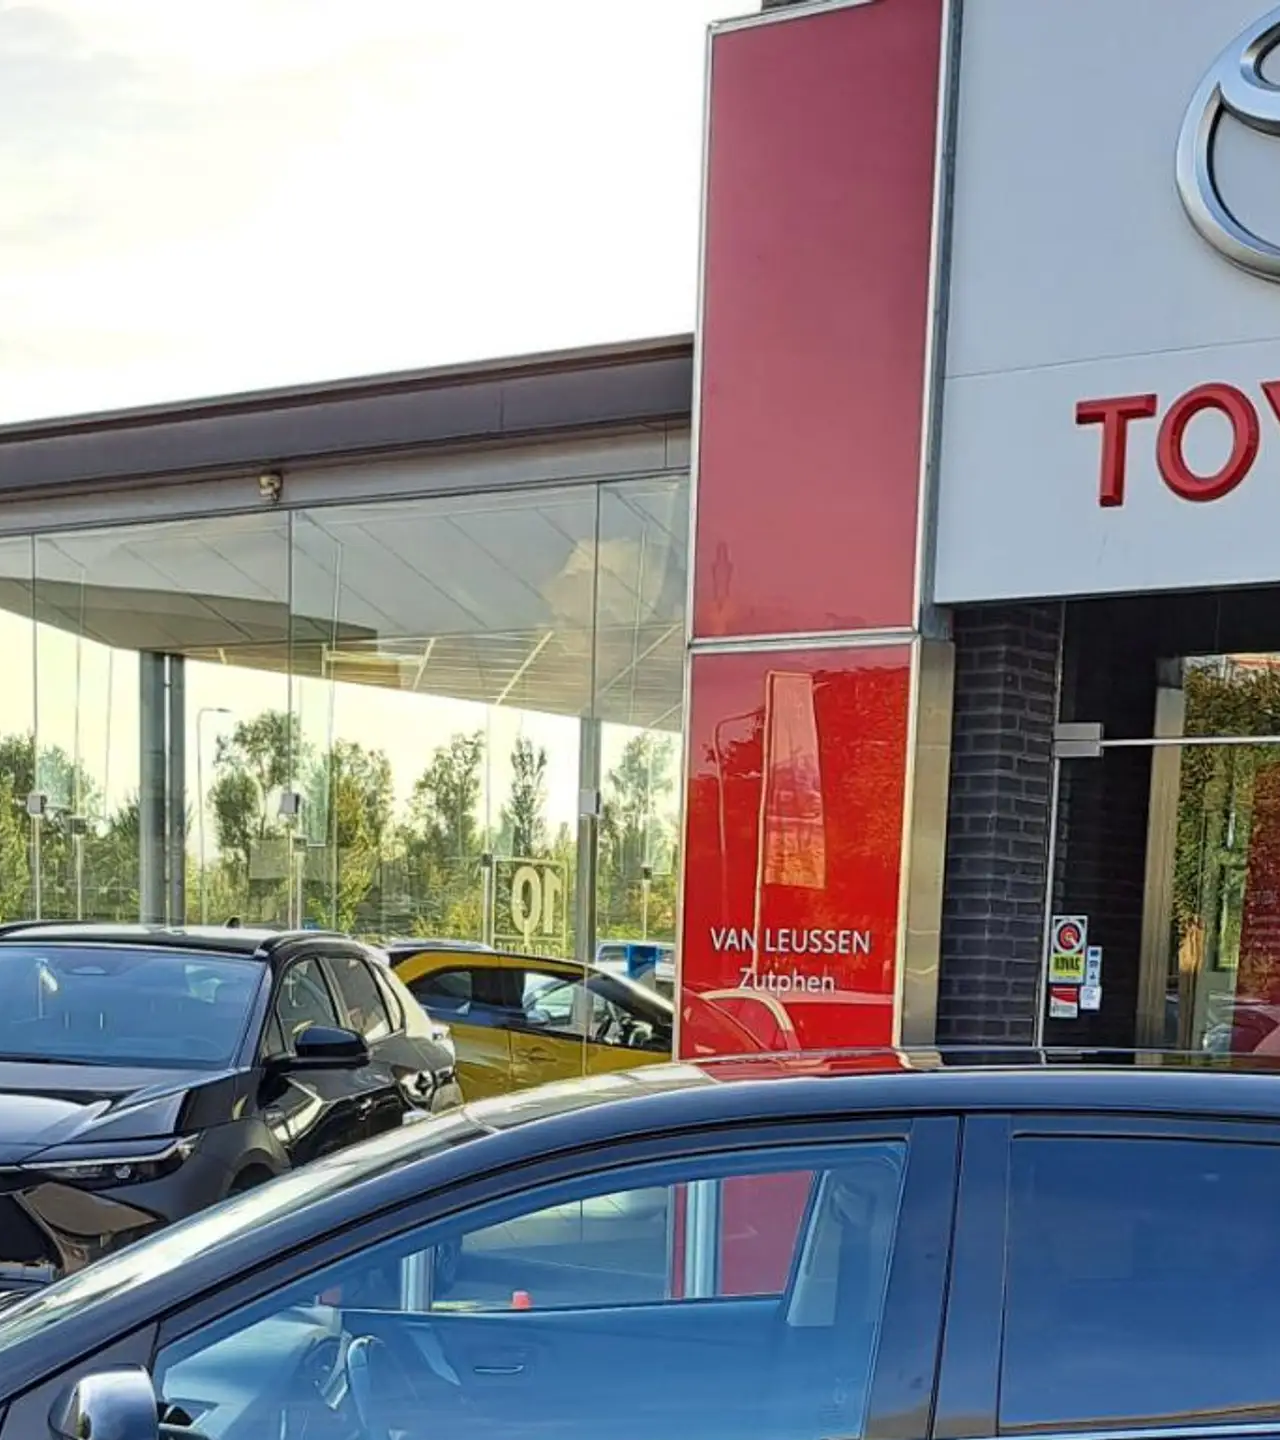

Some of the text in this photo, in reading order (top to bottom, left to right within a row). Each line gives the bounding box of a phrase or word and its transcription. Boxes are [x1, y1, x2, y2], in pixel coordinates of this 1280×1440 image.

[710, 926, 871, 954] VAN LEUSSEN
[738, 967, 835, 997] Zutphen
